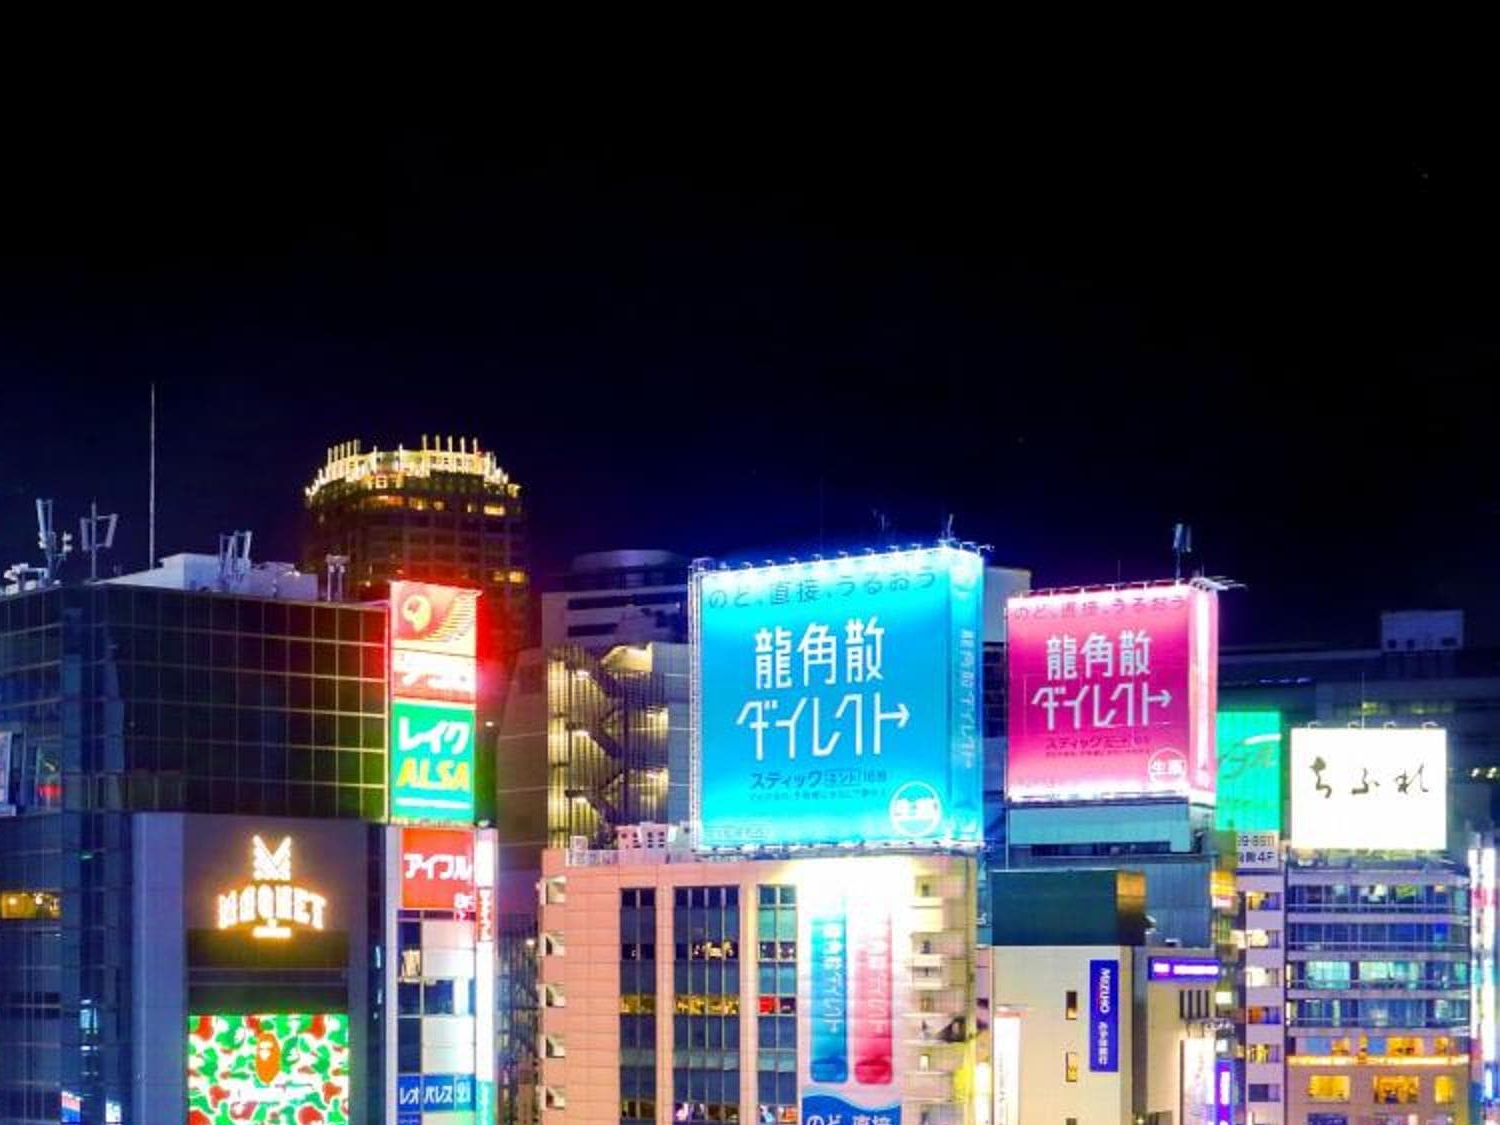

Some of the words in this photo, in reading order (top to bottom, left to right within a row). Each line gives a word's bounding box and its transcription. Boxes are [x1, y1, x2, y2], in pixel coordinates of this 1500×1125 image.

[754, 615, 885, 690] 龍角散
[1046, 630, 1152, 681] 龍角散
[736, 692, 911, 761] ダイレクト
[1031, 682, 1172, 731] ダイレクト
[398, 716, 470, 755] レイク
[396, 757, 470, 791] ALSA
[1310, 755, 1429, 799] ちふれ
[403, 853, 473, 880] アイフル
